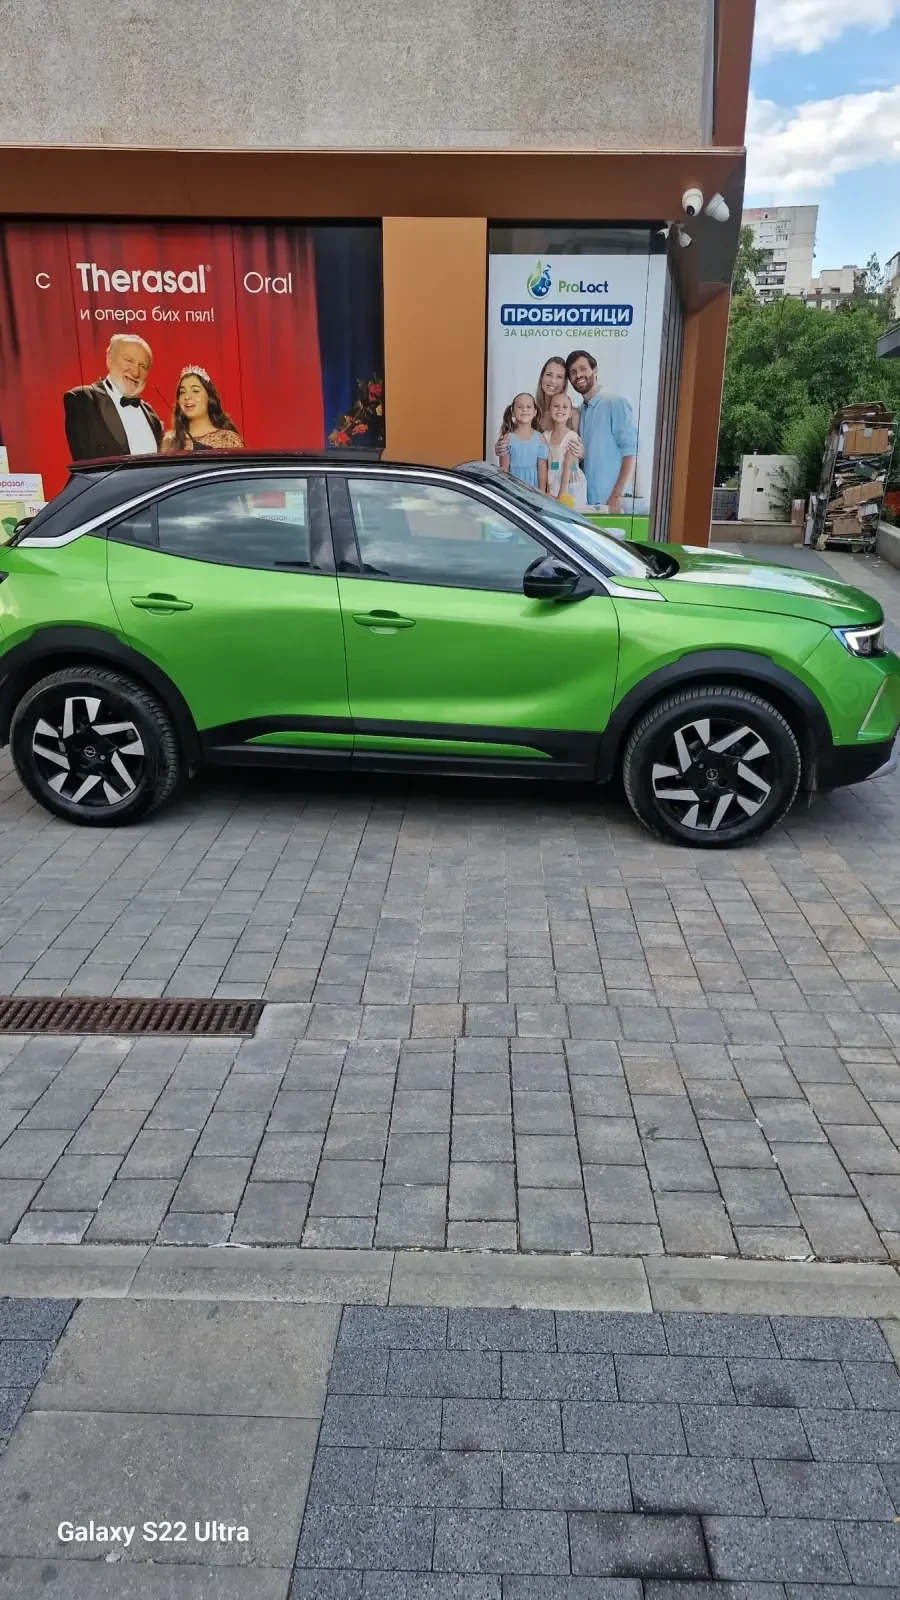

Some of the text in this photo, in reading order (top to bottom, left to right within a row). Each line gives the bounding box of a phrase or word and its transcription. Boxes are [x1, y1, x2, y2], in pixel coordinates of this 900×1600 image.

[243, 271, 293, 294] Oral
[558, 280, 609, 294] ProLact
[80, 305, 215, 323] и опера бих пял!
[503, 307, 630, 325] ПРОБИОТИЦИ
[503, 327, 629, 338] ЗА ЦЯЛОТО СЕМЕЙСТВО
